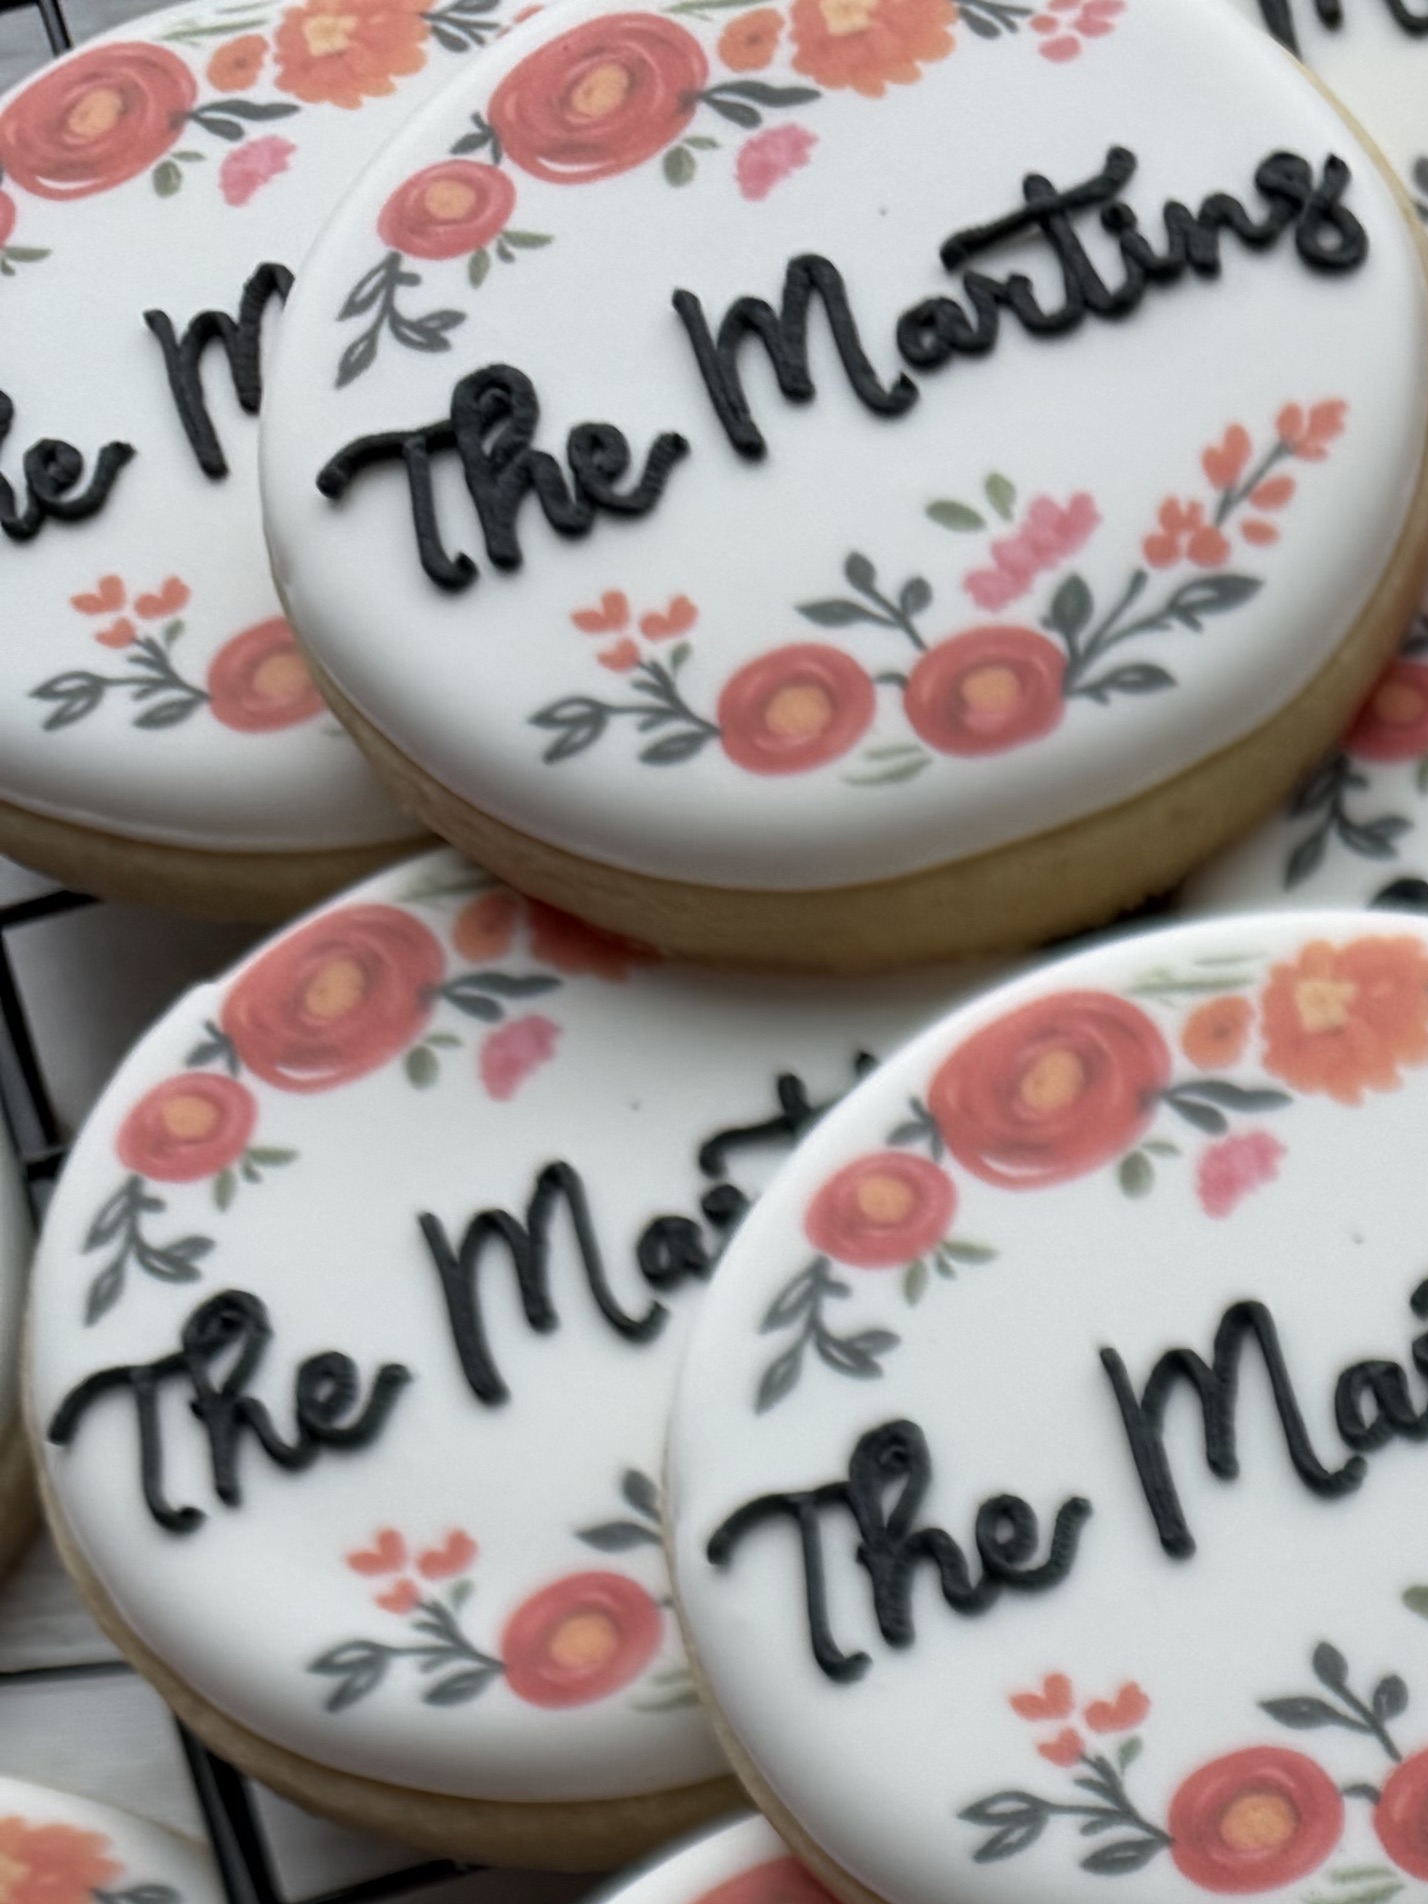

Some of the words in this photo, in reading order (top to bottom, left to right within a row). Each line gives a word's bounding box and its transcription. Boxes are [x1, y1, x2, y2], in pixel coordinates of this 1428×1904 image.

[316, 364, 689, 595] The
[671, 146, 1368, 463] Martins
[46, 1290, 410, 1535] The
[705, 1419, 1091, 1683] The
